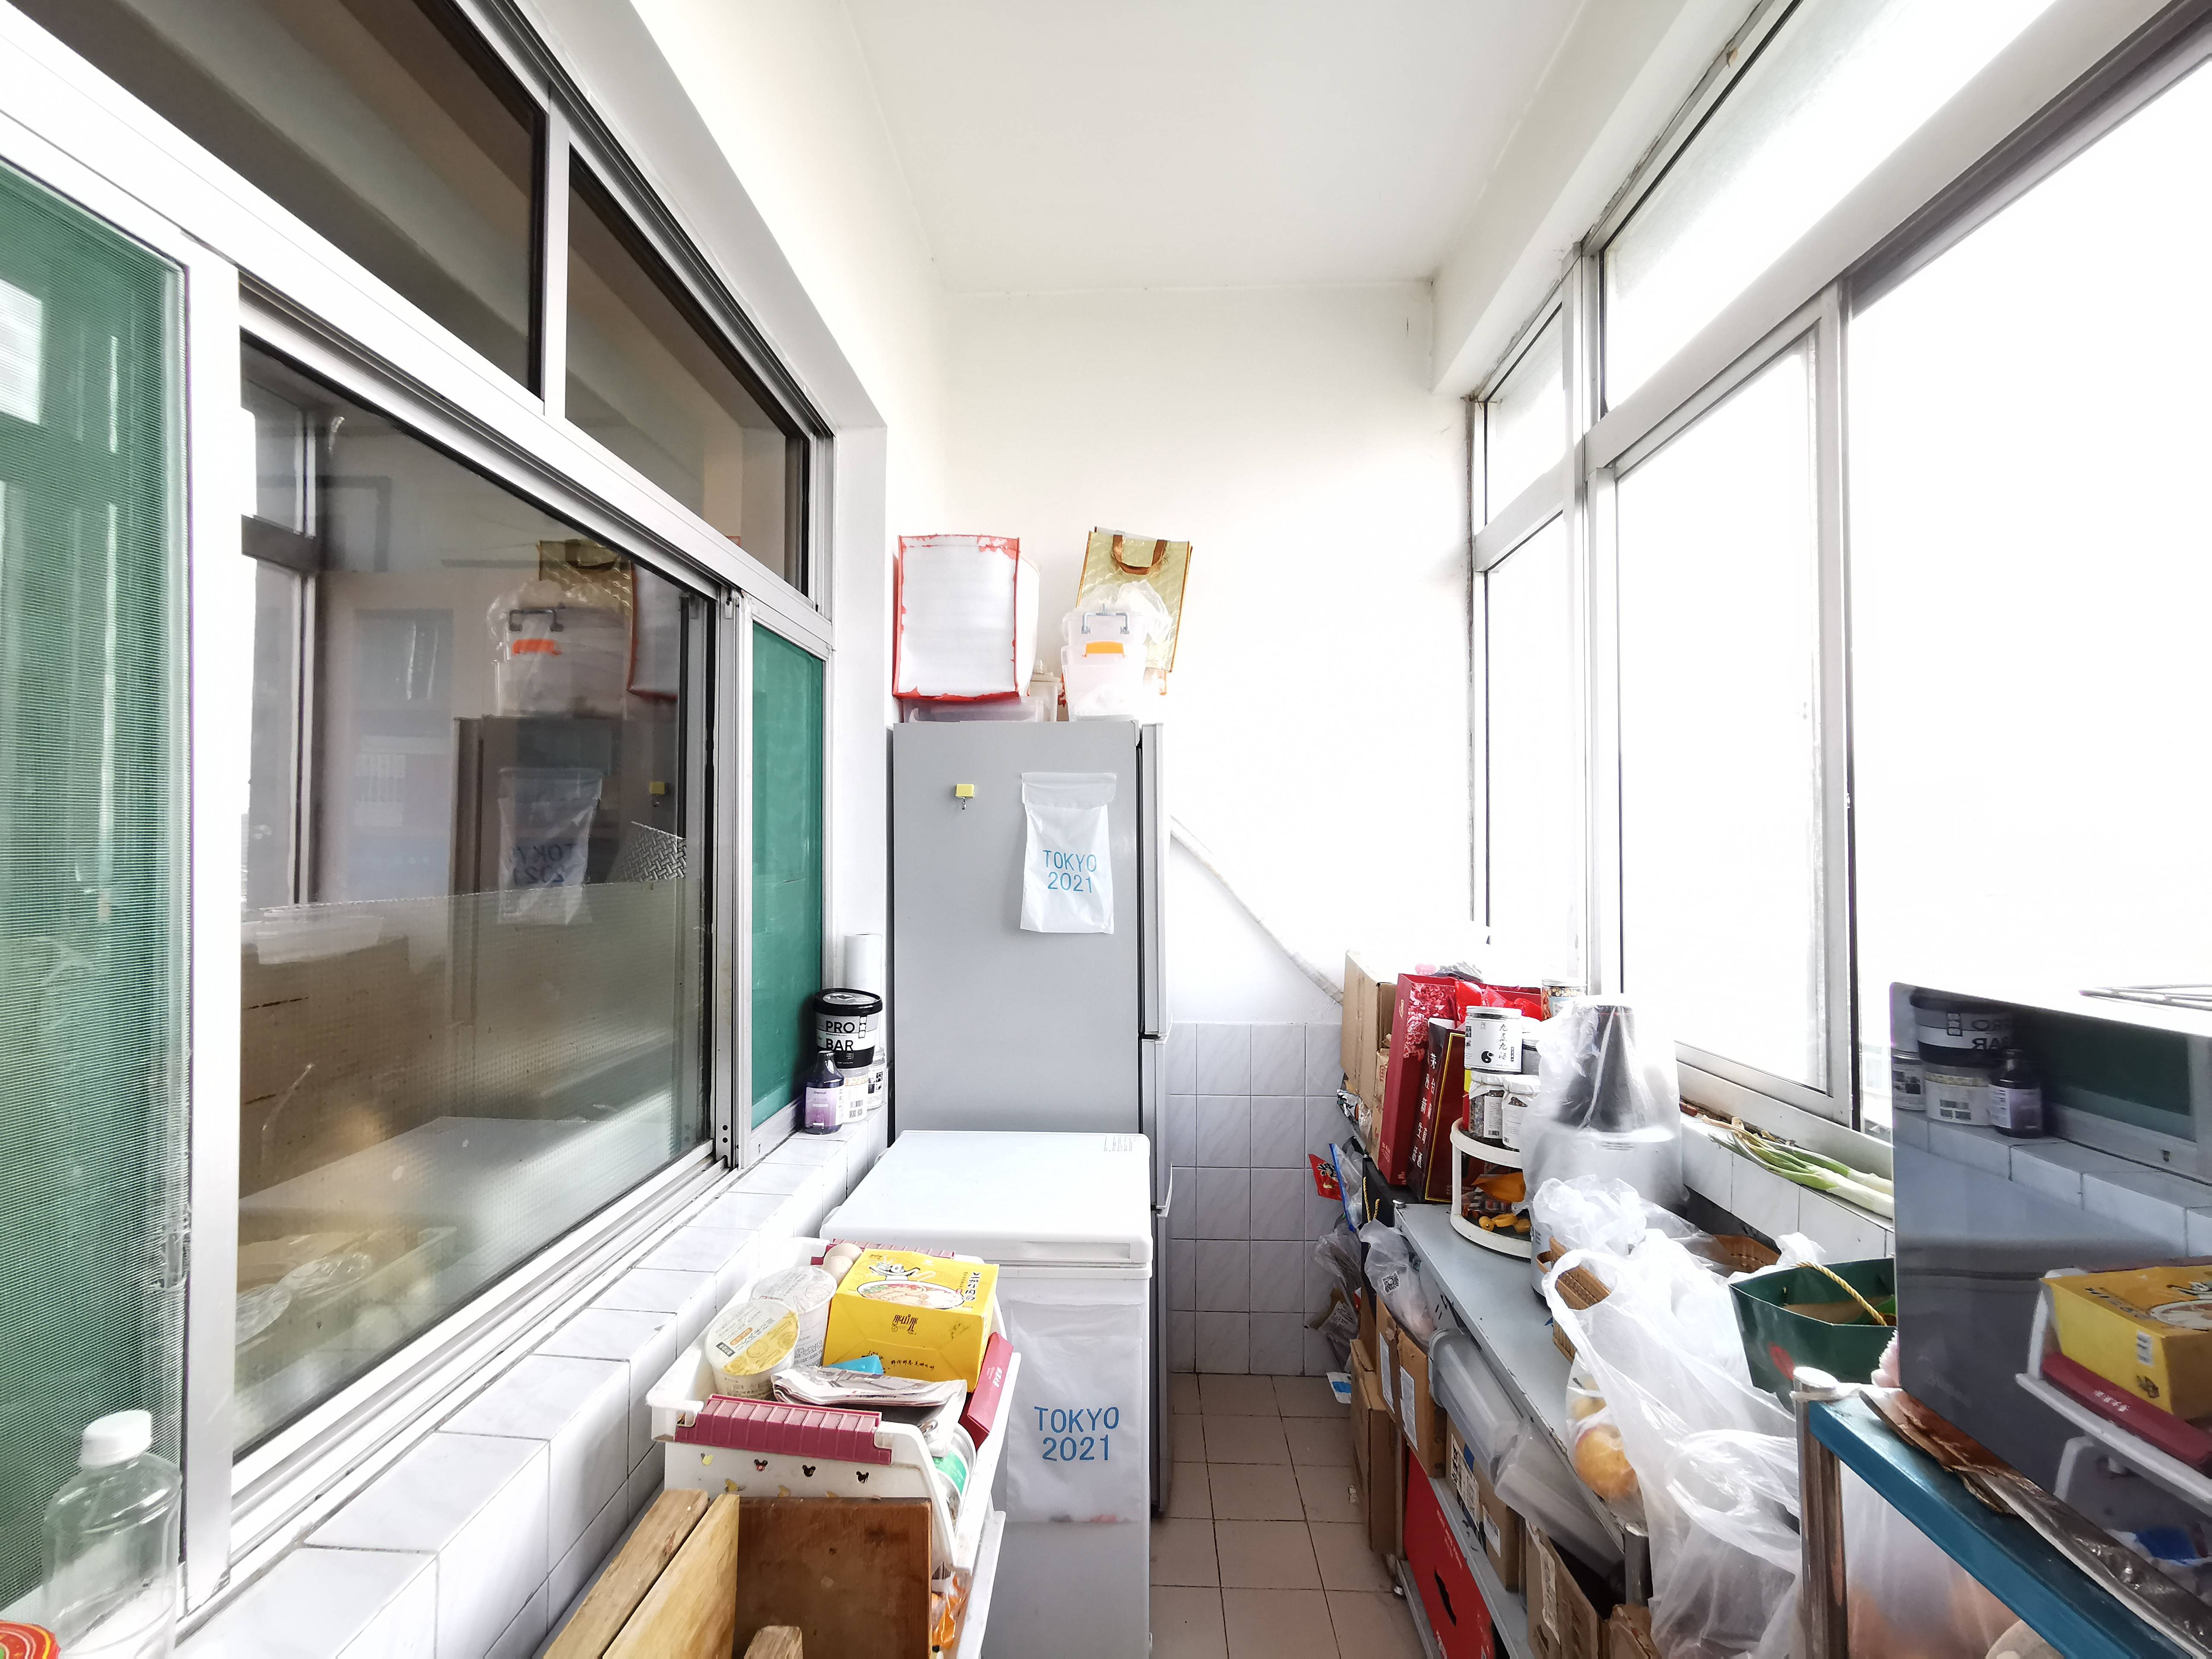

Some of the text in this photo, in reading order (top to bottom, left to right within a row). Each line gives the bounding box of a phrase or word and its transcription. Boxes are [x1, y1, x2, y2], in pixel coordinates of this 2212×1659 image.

[1042, 849, 1096, 872] TOKYO
[1048, 872, 1092, 893] 2021
[826, 1020, 855, 1033] PRO
[826, 1038, 853, 1051] BAR
[1034, 1406, 1119, 1433] TOKYO
[1042, 1434, 1109, 1461] 2021
